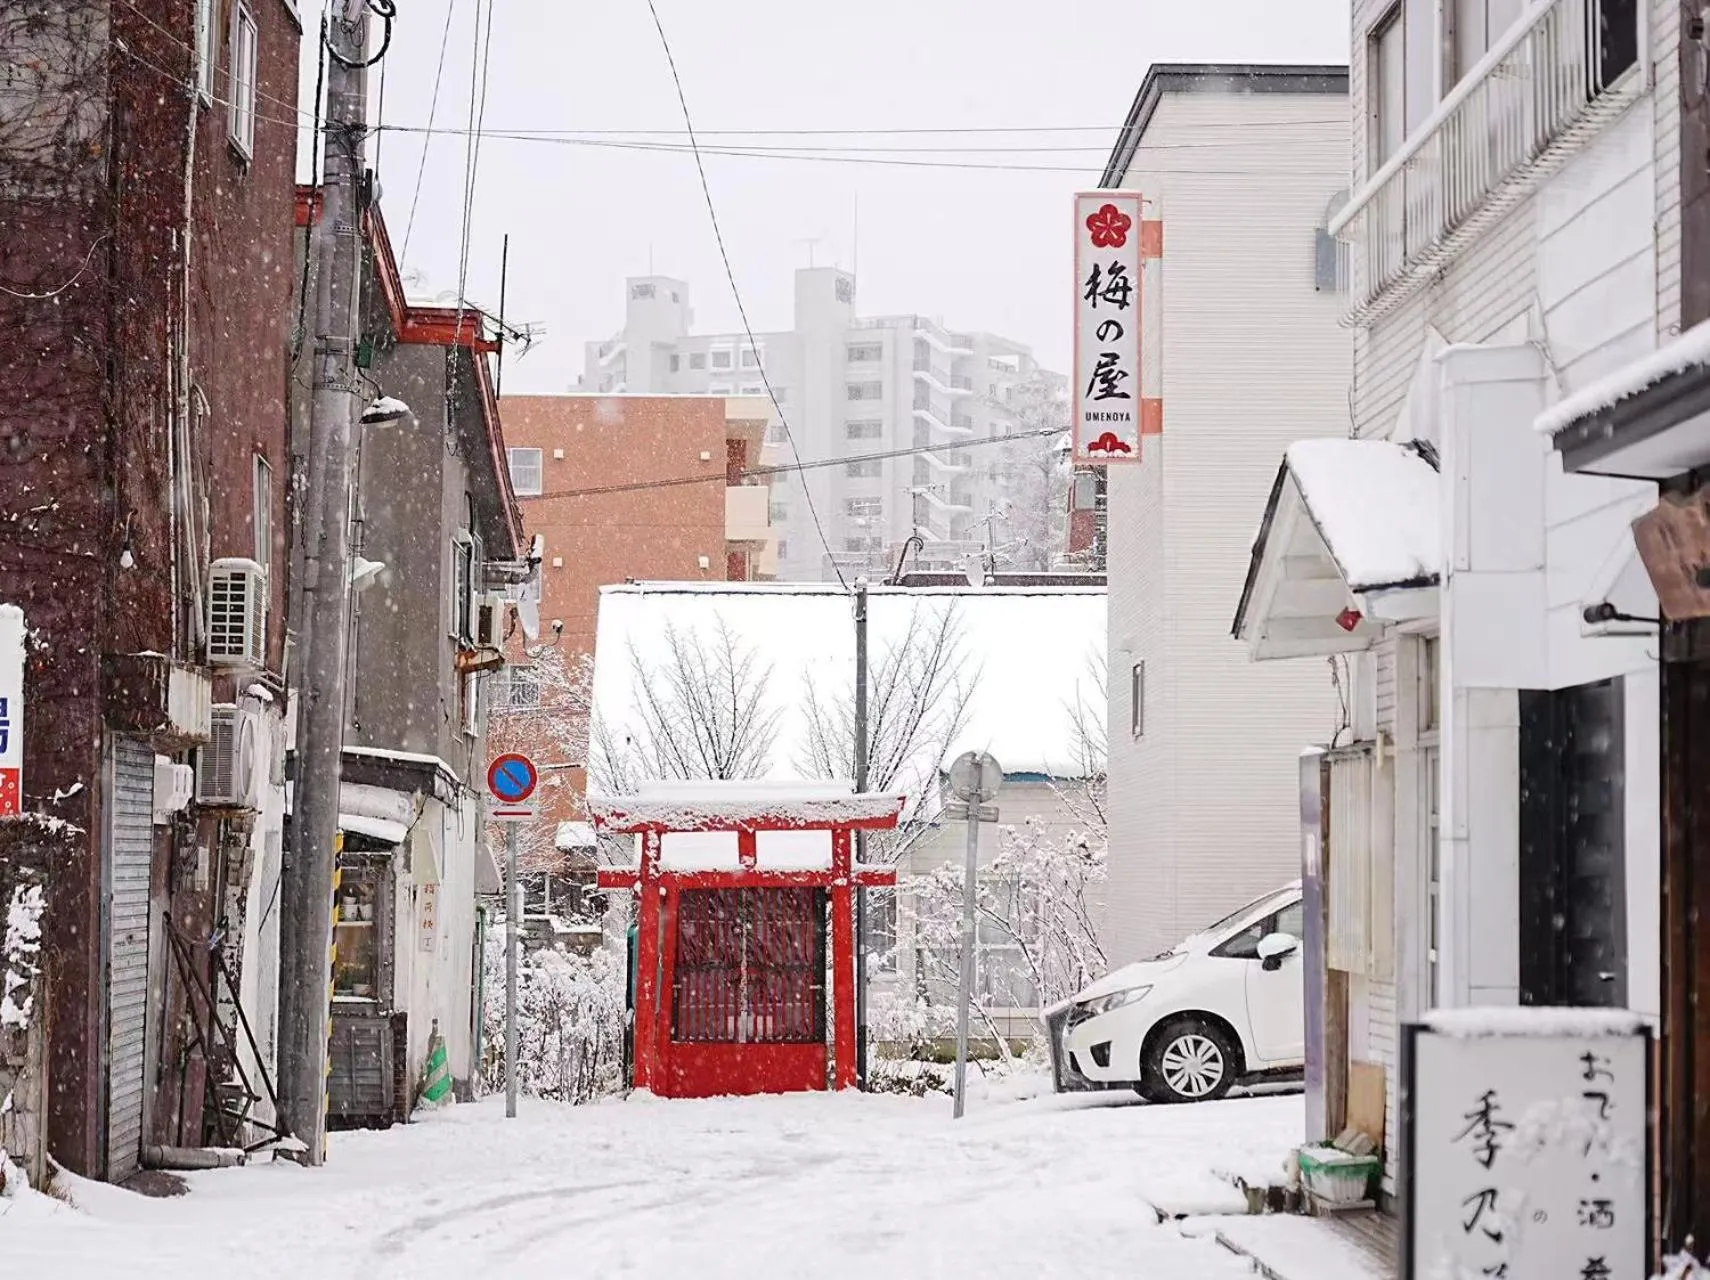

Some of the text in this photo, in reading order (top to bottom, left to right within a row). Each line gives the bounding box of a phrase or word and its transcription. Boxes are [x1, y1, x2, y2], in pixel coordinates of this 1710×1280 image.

[1084, 260, 1133, 401] 梅の屋
[1085, 412, 1131, 422] UMENOYA
[1450, 1089, 1516, 1280] 季乃
